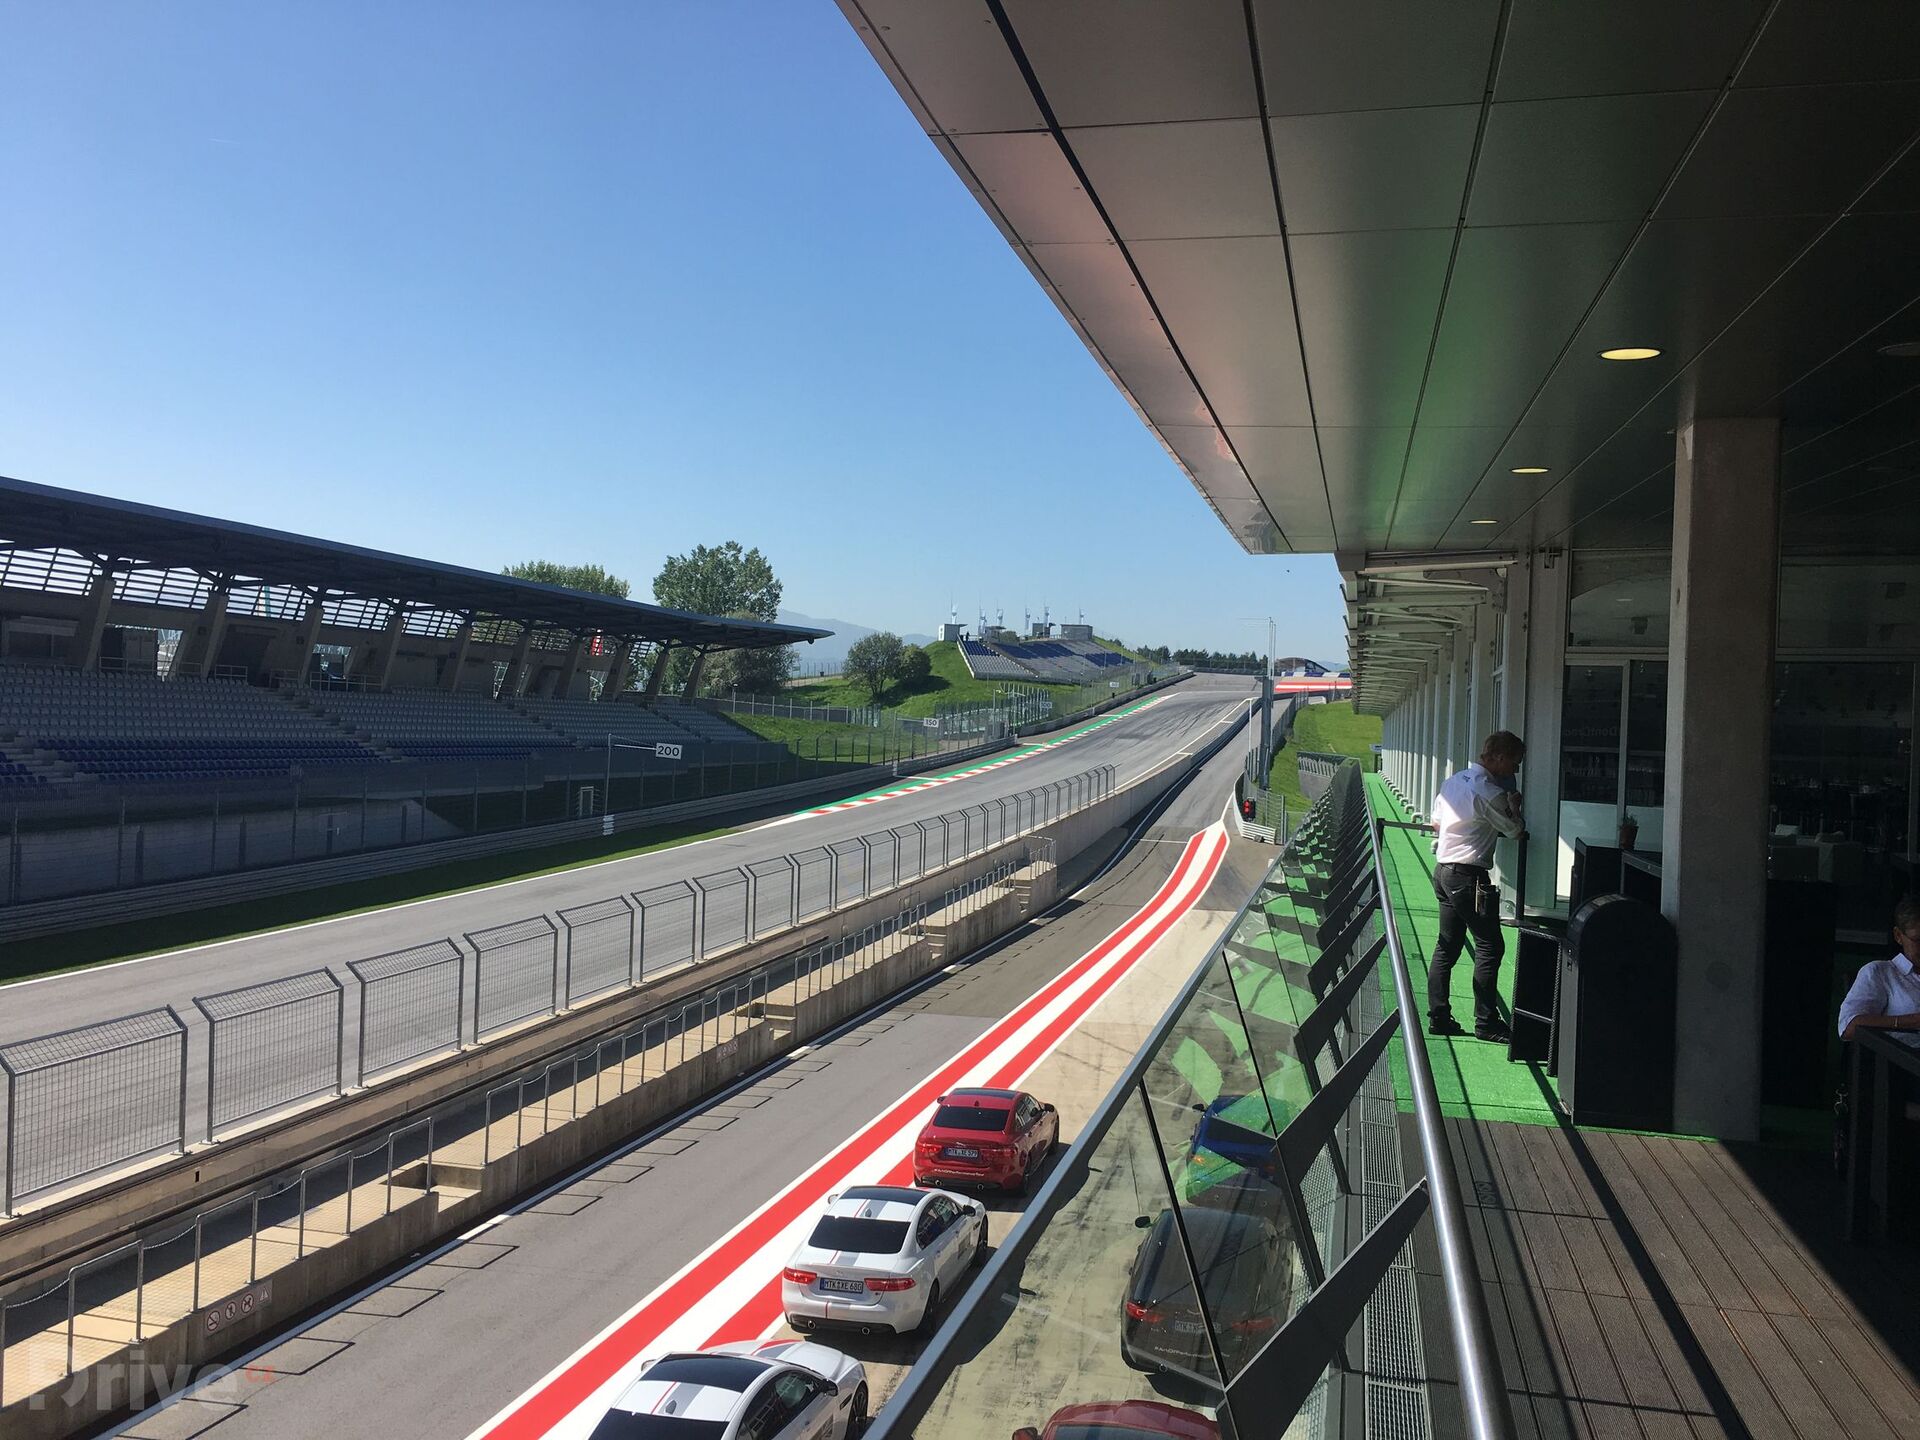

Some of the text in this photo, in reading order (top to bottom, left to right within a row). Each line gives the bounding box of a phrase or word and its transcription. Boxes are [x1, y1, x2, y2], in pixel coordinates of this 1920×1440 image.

[657, 745, 680, 757] 200
[824, 1279, 837, 1288] MTK
[840, 1281, 850, 1290] XE
